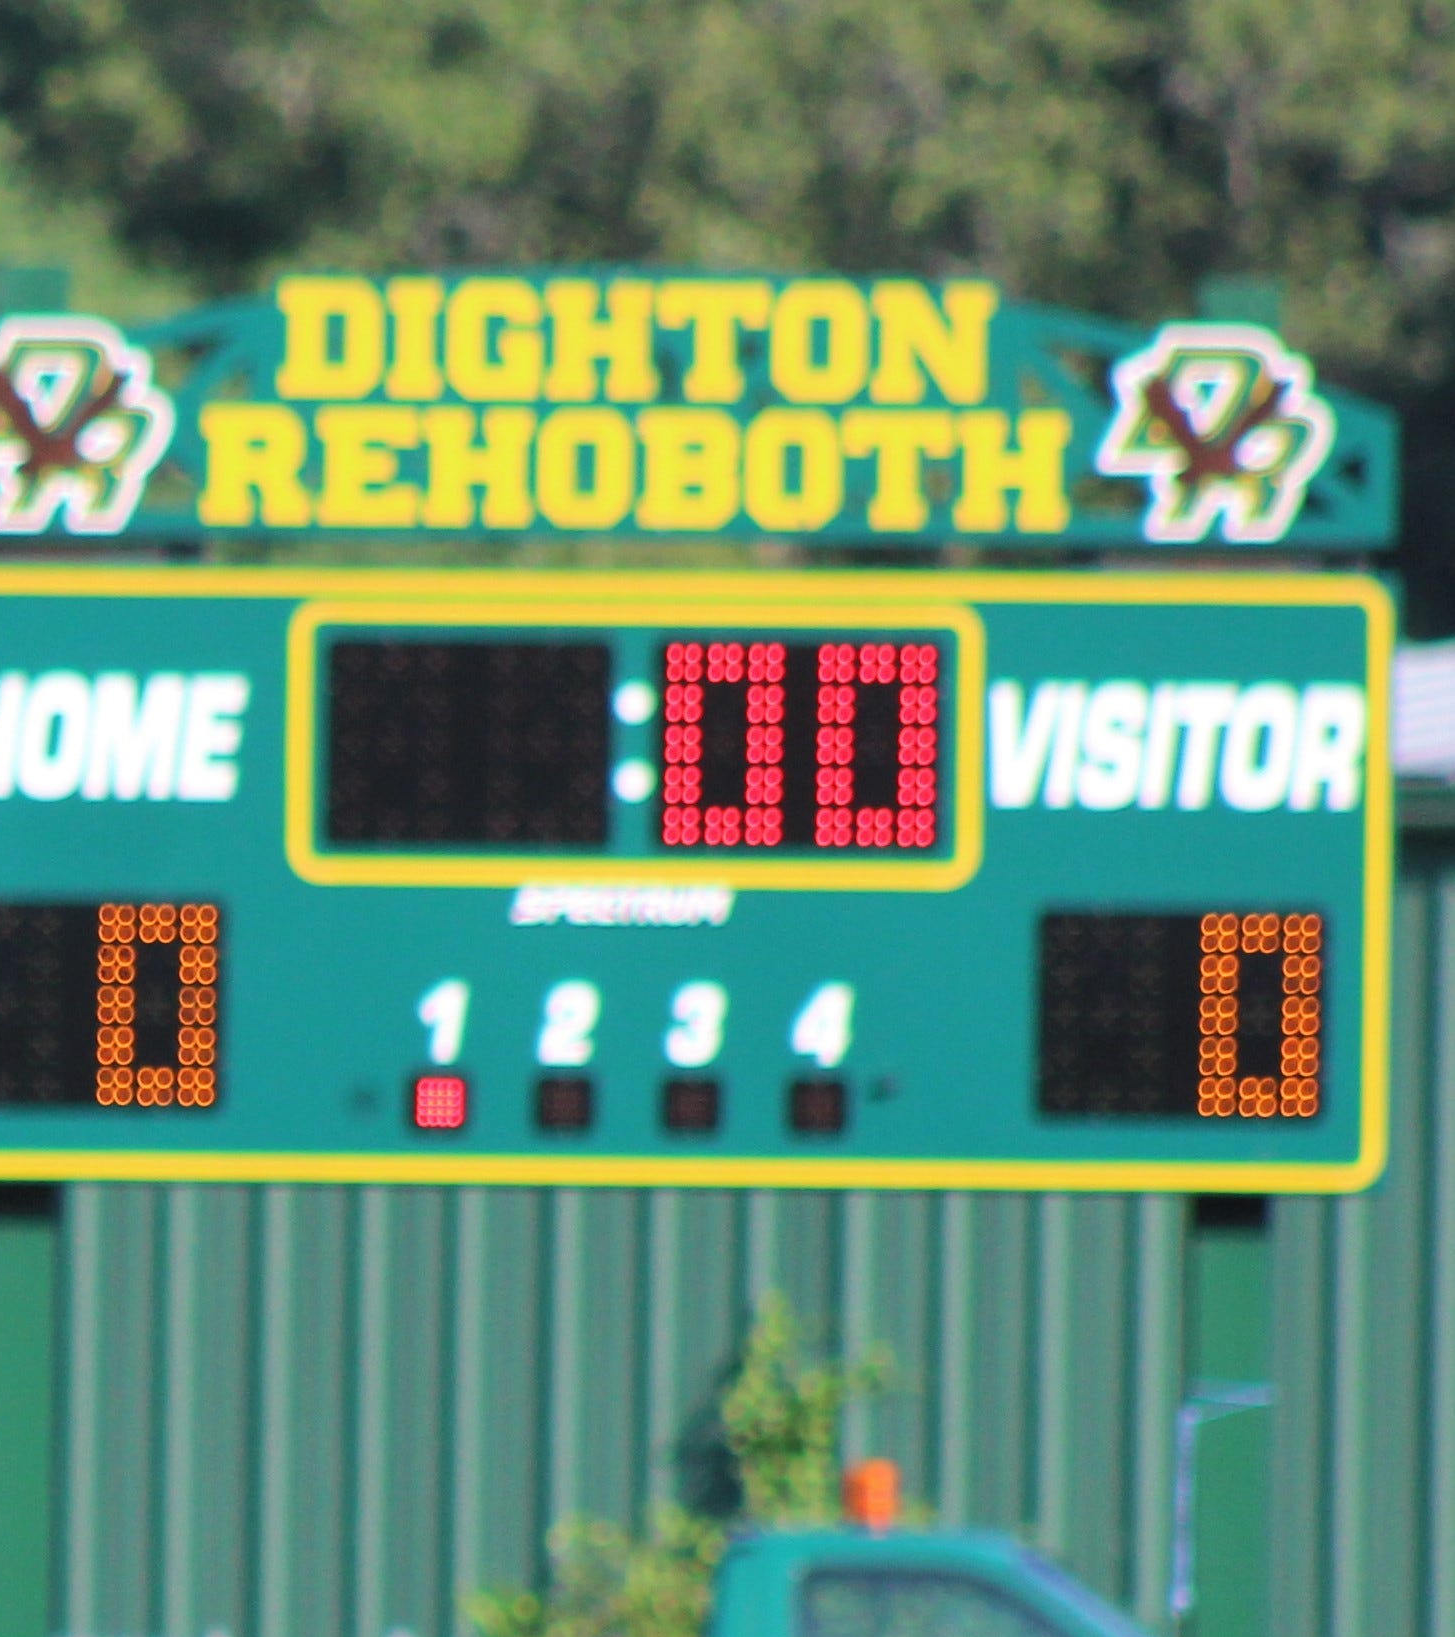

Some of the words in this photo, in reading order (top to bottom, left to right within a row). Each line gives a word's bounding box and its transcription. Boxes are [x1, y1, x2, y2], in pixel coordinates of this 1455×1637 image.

[276, 276, 998, 405] DIGHTON
[198, 404, 1073, 534] REHOBOTH
[988, 677, 1370, 812] VISITOR
[97, 903, 219, 1107] 0
[418, 977, 470, 1066] 1
[536, 978, 602, 1068] 2
[665, 979, 728, 1069] 3
[791, 980, 856, 1069] 4
[1197, 912, 1323, 1118] 0
